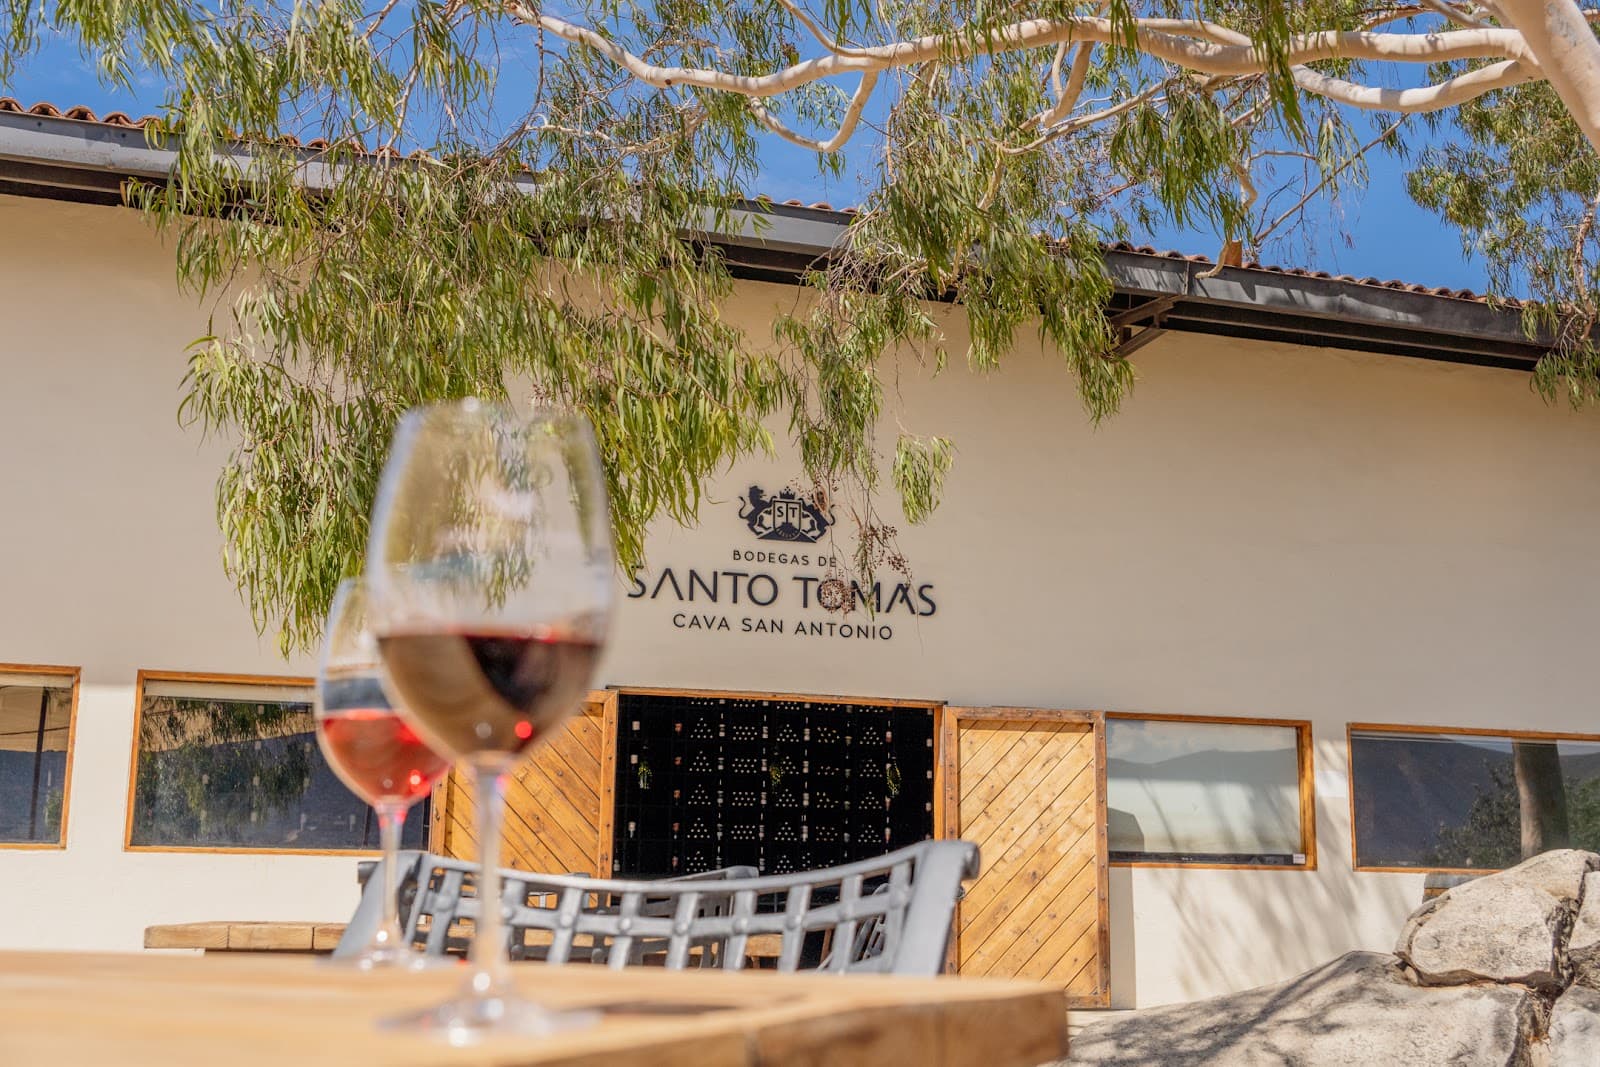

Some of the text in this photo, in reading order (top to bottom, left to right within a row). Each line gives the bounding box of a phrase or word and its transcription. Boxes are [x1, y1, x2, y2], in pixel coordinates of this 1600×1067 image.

[733, 550, 837, 567] BODEGAS DE
[627, 565, 779, 607] SANTO
[673, 613, 893, 640] CAVA SAN ANTONIO
